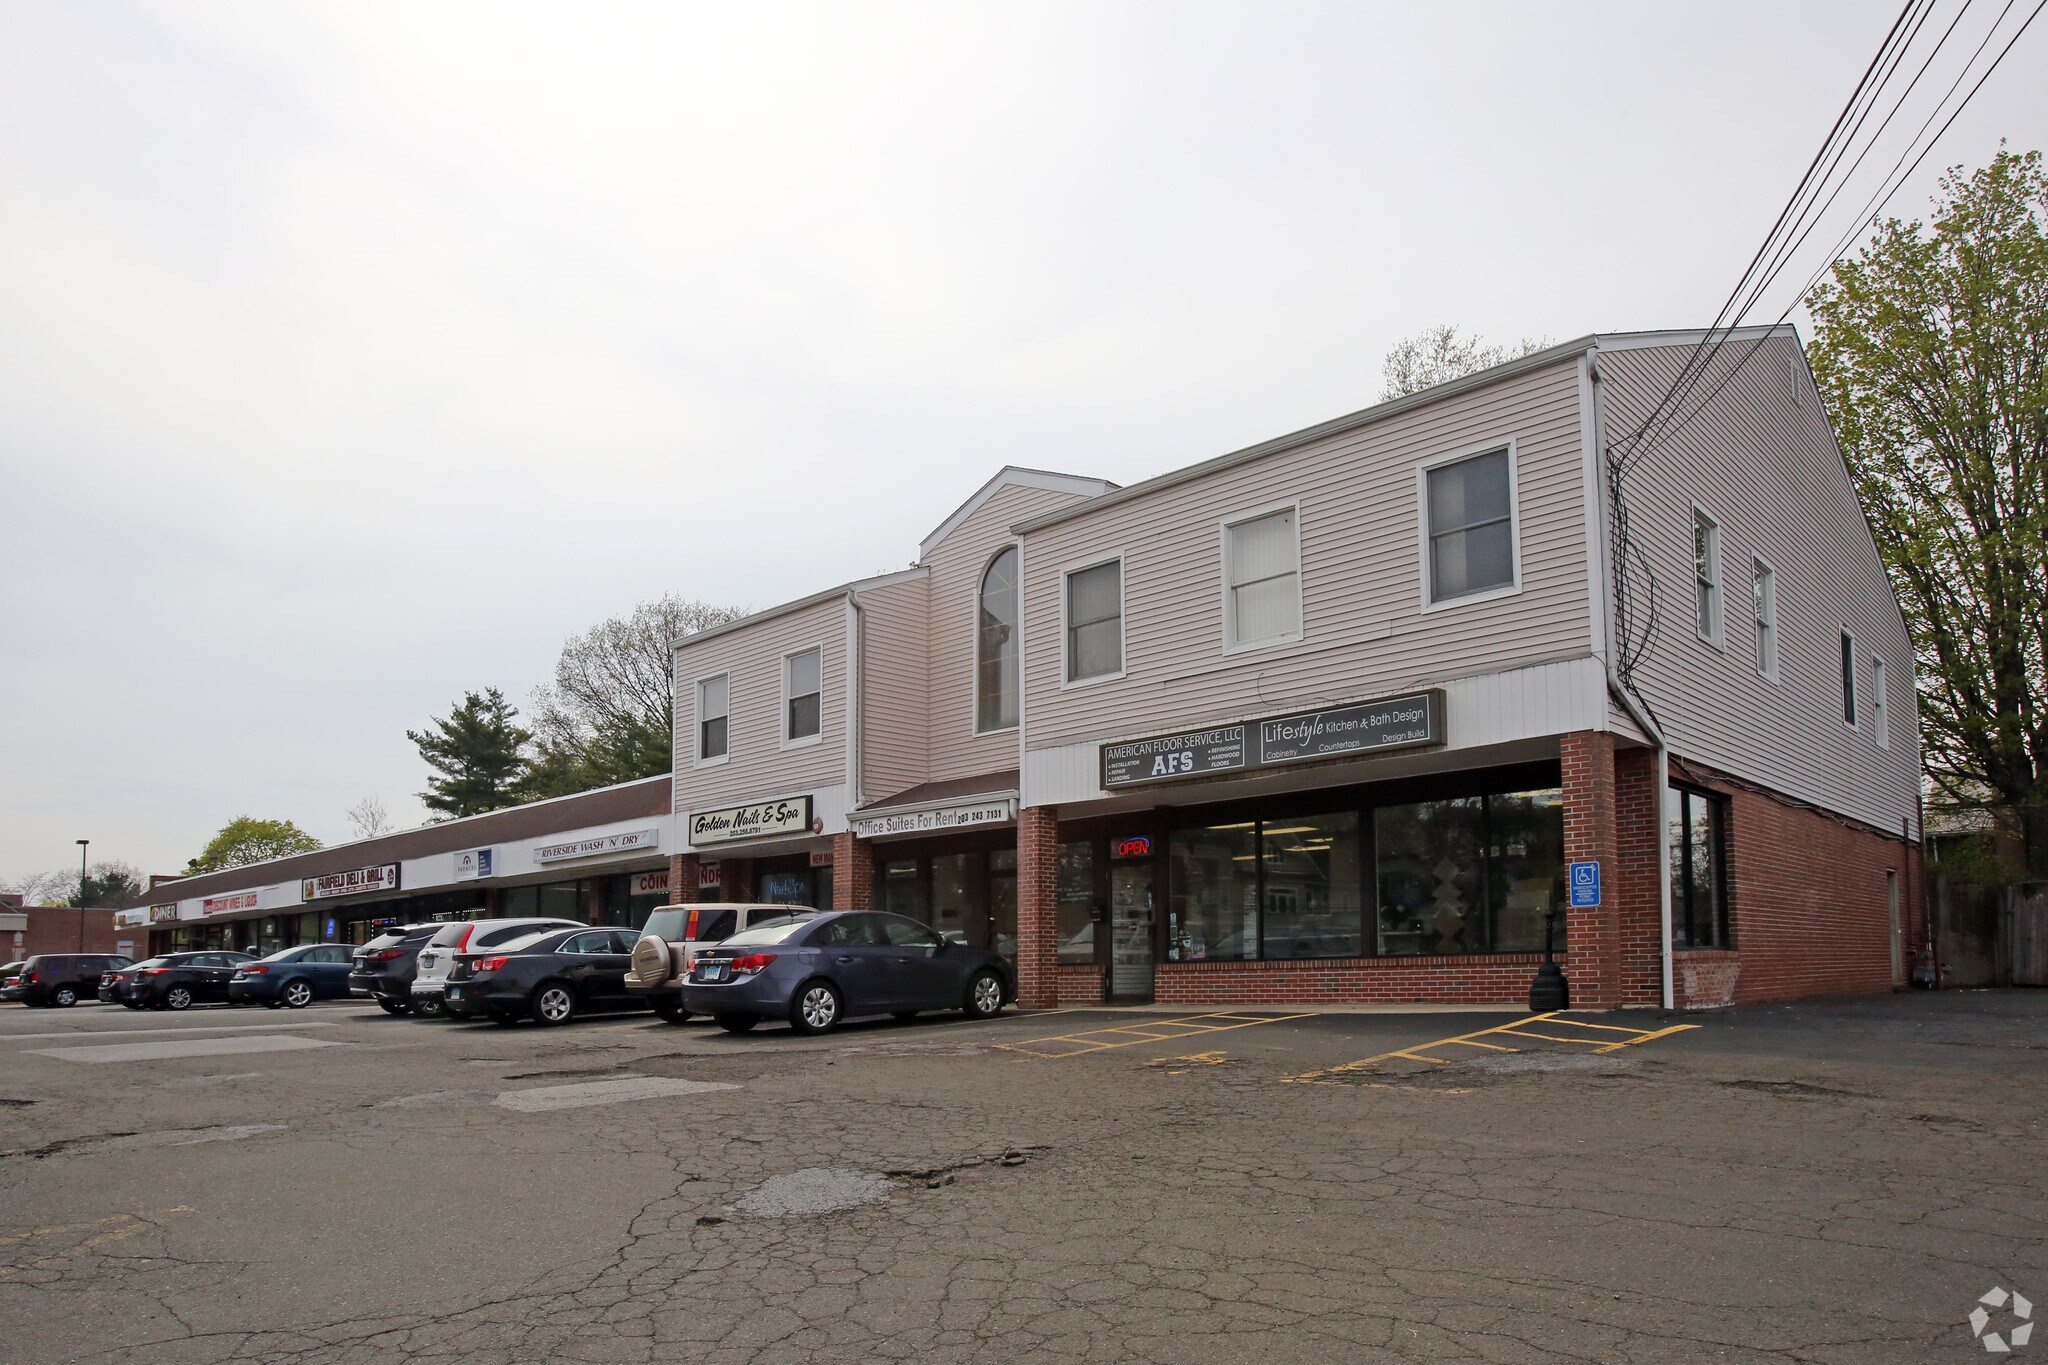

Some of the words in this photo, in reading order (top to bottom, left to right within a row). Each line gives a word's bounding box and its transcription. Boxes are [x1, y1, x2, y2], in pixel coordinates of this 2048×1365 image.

[1265, 714, 1324, 747] Lifestyle
[1325, 719, 1359, 734] Kitchen
[1359, 718, 1369, 729] &
[1370, 712, 1391, 727] Bath
[1392, 708, 1424, 723] Design
[1107, 743, 1152, 760] AMERICAN
[1153, 738, 1183, 753] FLOOR
[1184, 732, 1223, 748] SERVICE,
[1224, 728, 1242, 742] LLC
[1382, 732, 1407, 745] Design
[1407, 728, 1425, 739] Build
[1211, 744, 1241, 753] REFINISHING
[1266, 748, 1298, 760] Cabinetry
[1318, 739, 1360, 753] Countertops
[1111, 759, 1140, 769] INSTALLATION
[1151, 750, 1193, 776] AFS
[1211, 751, 1240, 761] HARDWOOD
[1211, 759, 1230, 768] FLOORS
[694, 815, 732, 835] Golden
[732, 808, 761, 829] Nails
[762, 805, 774, 824] &
[775, 802, 801, 826] Spa
[858, 820, 884, 835] Office
[886, 815, 915, 832] Suites
[917, 813, 932, 829] For
[935, 809, 958, 827] Rent
[957, 813, 969, 825] 203
[971, 810, 983, 822] 243
[986, 809, 1002, 820] 7131
[541, 844, 578, 858] RIVERSIDE
[580, 840, 604, 852] WASH
[621, 834, 641, 846] DRY
[1118, 840, 1149, 856] OPEN
[318, 874, 345, 890] FAIRFIELD
[346, 871, 359, 887] DELI
[366, 867, 384, 883] GRILL
[640, 874, 668, 890] COIN
[154, 904, 176, 921] DINER
